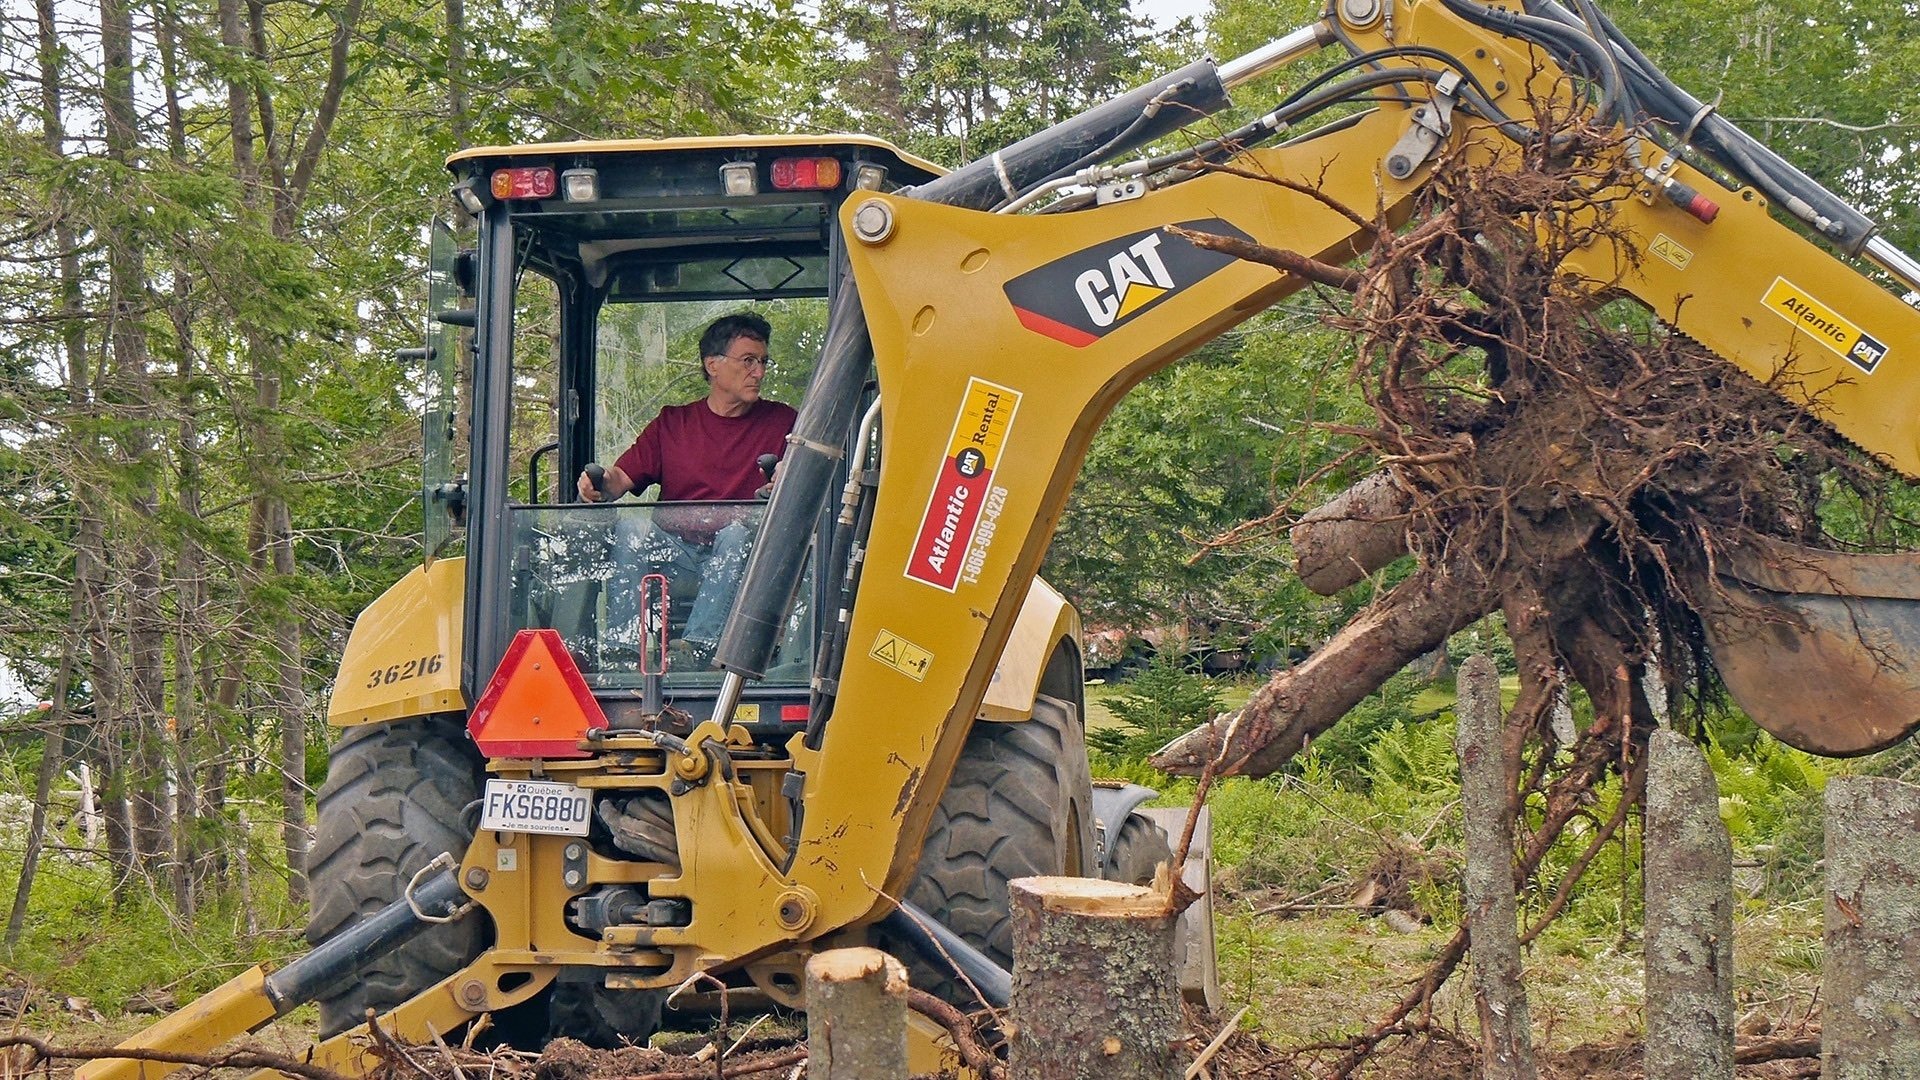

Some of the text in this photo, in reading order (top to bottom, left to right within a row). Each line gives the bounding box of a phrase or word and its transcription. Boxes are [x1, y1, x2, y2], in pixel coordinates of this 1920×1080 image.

[1074, 232, 1176, 327] CAT
[1781, 297, 1882, 364] Atlantic CAT
[927, 392, 1000, 574] Atlantic CAT Rental
[963, 486, 1009, 584] 1-866-999-4228
[366, 654, 444, 689] 36216
[488, 793, 587, 823] FKS6880
[527, 785, 562, 796] Québec
